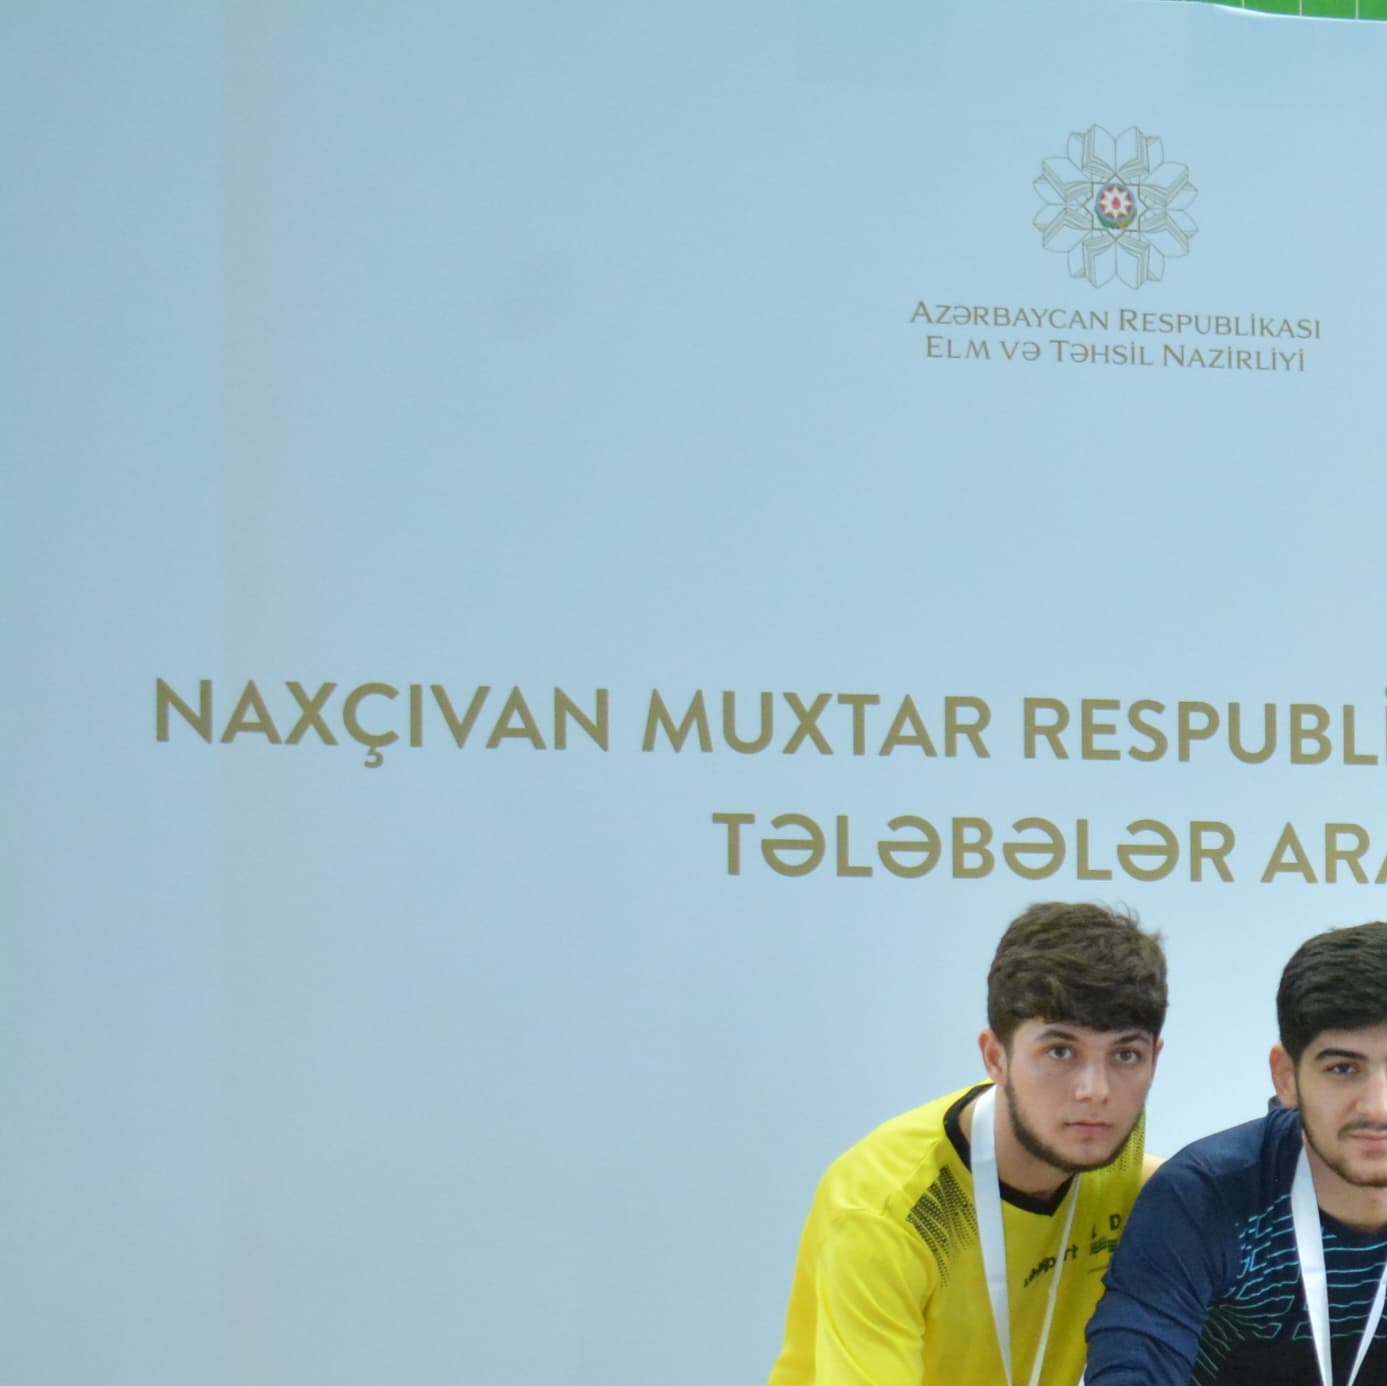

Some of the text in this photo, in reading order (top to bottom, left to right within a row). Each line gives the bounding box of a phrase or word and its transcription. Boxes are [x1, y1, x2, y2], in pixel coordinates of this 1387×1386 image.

[909, 300, 1321, 339] AZƏRBAYCAN RESPUBLİKASI
[926, 335, 1305, 372] ELM VƏ TƏHSİL NAZİRLİYİ
[155, 677, 609, 769] NAXÇIVAN
[641, 687, 992, 760] MUXTAR
[711, 811, 1236, 883] TƏLƏBƏLƏR
